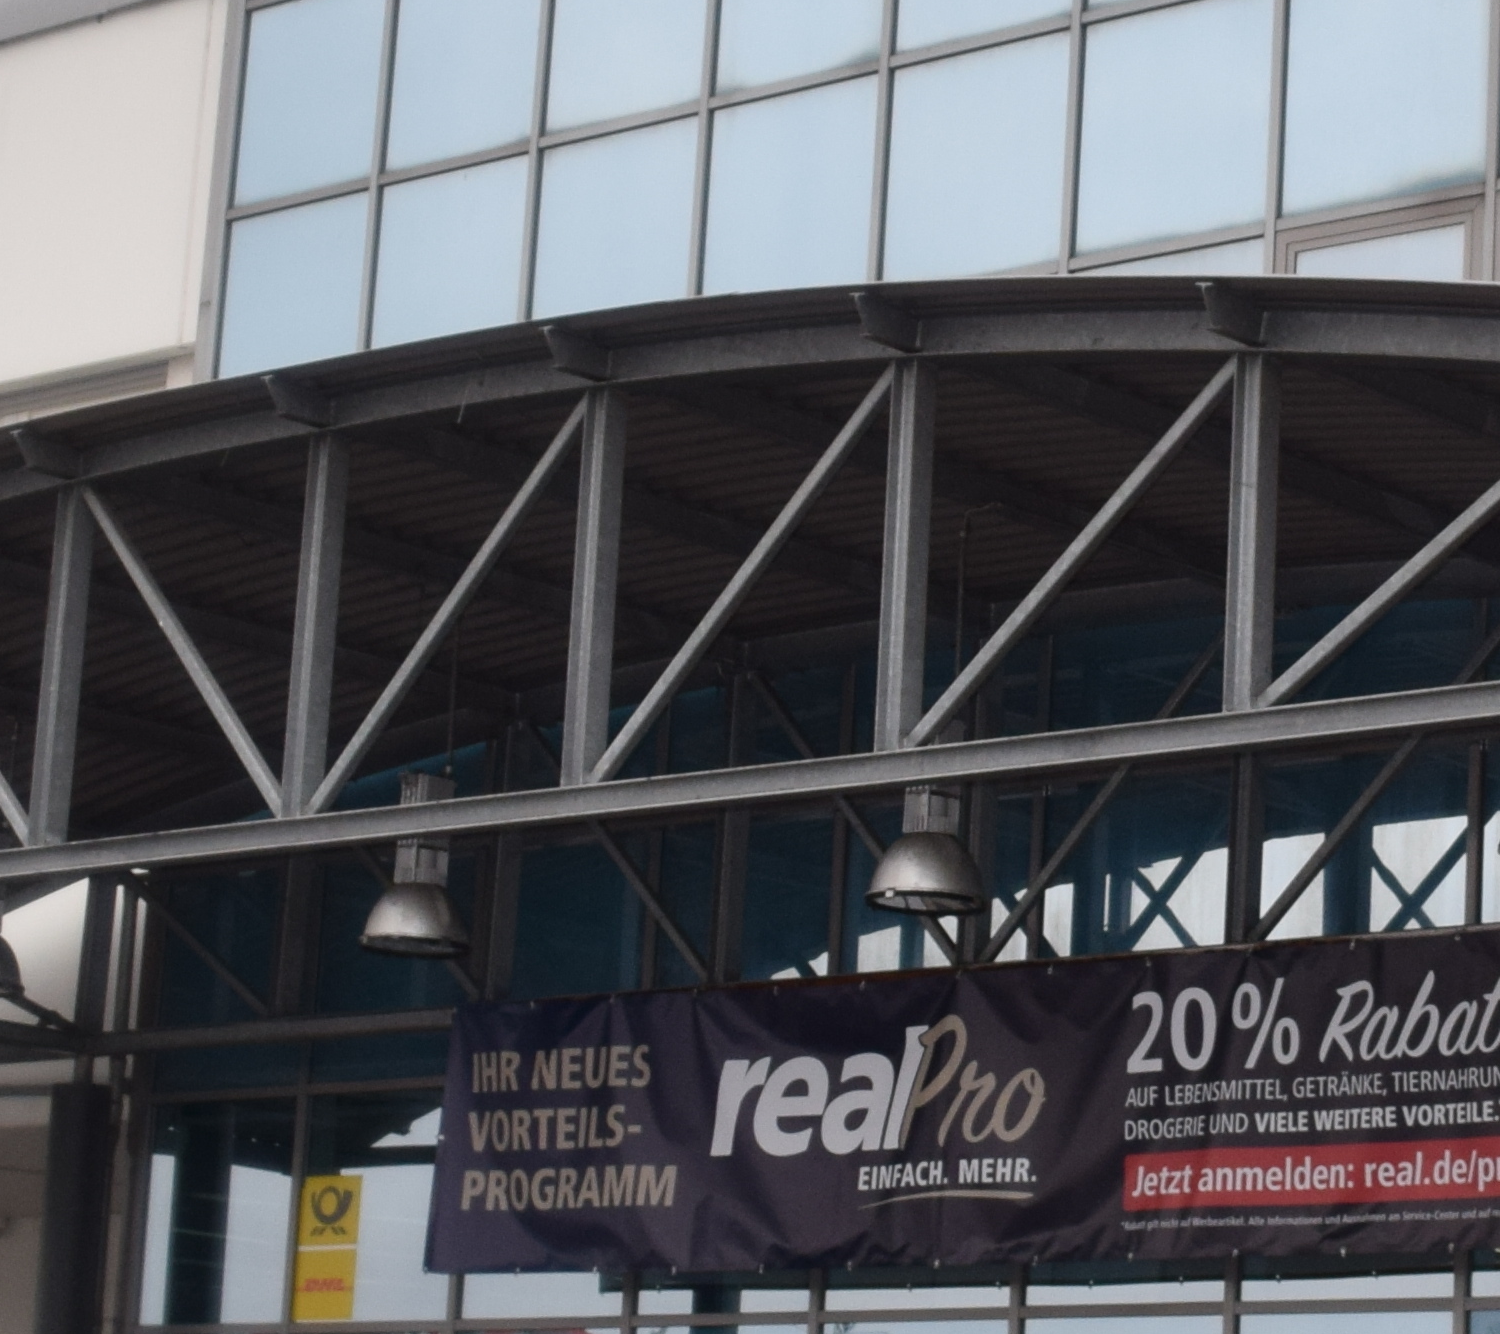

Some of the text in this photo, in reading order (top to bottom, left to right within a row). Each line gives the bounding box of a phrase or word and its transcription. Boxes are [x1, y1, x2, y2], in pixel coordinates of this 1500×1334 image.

[1126, 986, 1218, 1073] 20
[1232, 977, 1299, 1069] %
[472, 1045, 651, 1094] IHR NEUES
[1125, 1085, 1159, 1108] AUF
[1165, 1078, 1288, 1106] LEBENSMITTEL,
[1292, 1070, 1387, 1099] GETRÄNKE,
[468, 1104, 642, 1153] VORTEILS-
[1124, 1114, 1204, 1141] DROGERIE
[1209, 1113, 1249, 1135] UND
[1255, 1111, 1308, 1133] VIELE
[1314, 1106, 1397, 1131] WEITERE
[460, 1164, 677, 1211] PROGRAMM
[857, 1157, 1038, 1192] EINFACH. MEHR.
[1132, 1165, 1192, 1198] Jetzt
[1198, 1156, 1355, 1193] anmelden:
